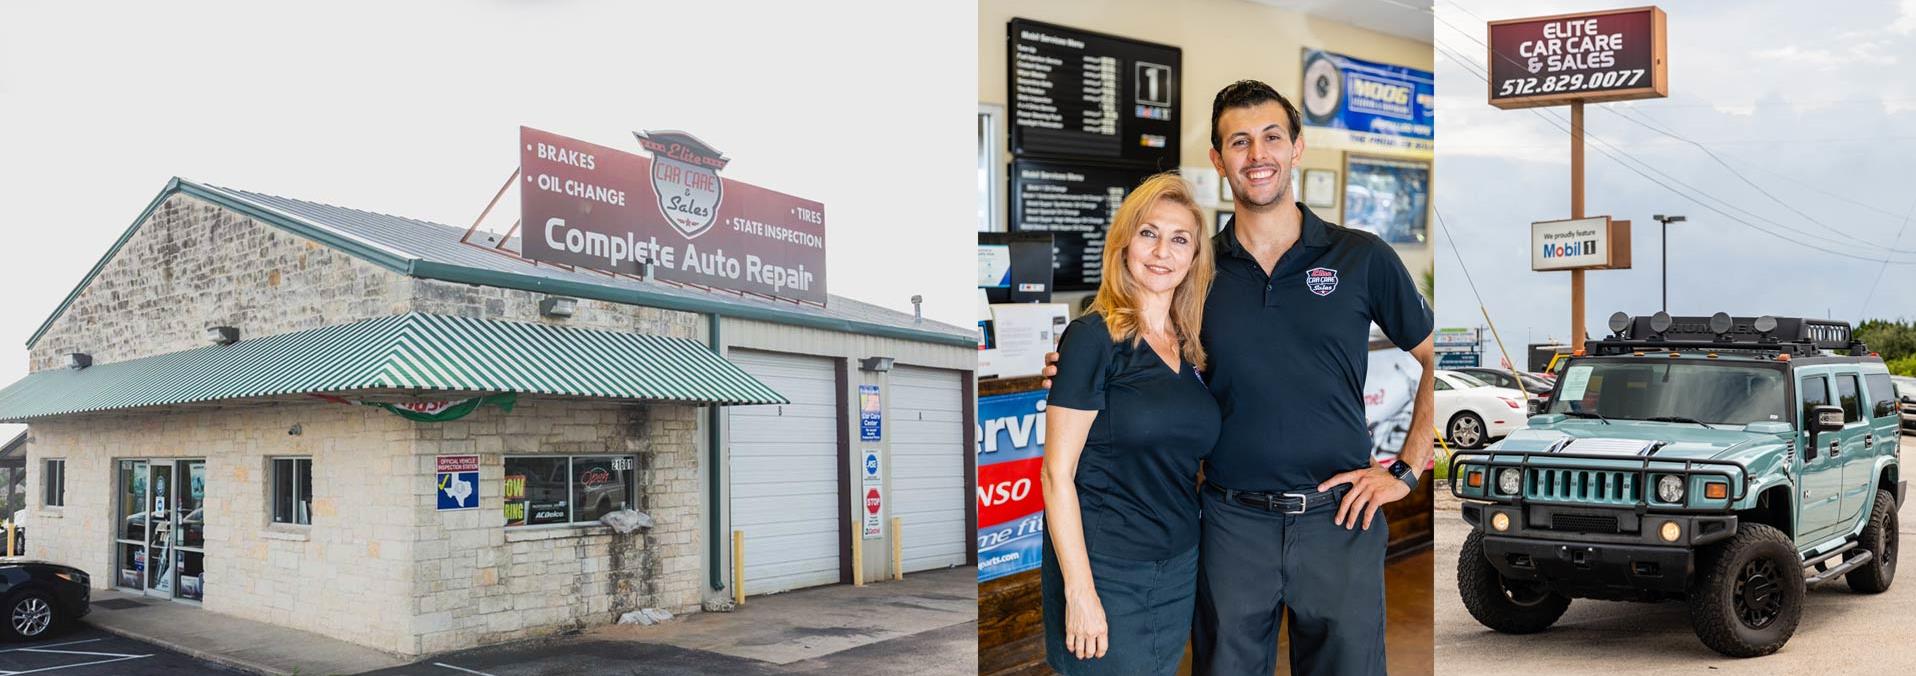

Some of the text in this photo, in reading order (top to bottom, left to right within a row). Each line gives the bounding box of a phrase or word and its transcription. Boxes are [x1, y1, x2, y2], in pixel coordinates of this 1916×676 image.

[1543, 19, 1597, 39] ELITE
[1520, 33, 1622, 58] CAR CARE
[1528, 51, 1615, 73] & SALES
[1354, 79, 1409, 104] MOOG
[1500, 70, 1645, 96] 512.829.0077
[538, 143, 595, 170] BRAKES
[668, 144, 702, 164] Elite
[656, 163, 714, 192] CAR CARE
[538, 174, 625, 207] OIL CHANGE
[685, 188, 690, 196] &
[667, 196, 708, 217] Sales
[797, 208, 822, 224] TIRES
[733, 217, 822, 249] STATE INSPECTION
[1554, 231, 1575, 240] proudly
[1576, 229, 1596, 237] feature
[545, 217, 813, 292] Complete Auto Repair
[1543, 241, 1594, 258] Mobil 1
[581, 470, 609, 486] Open
[867, 497, 880, 506] STOP
